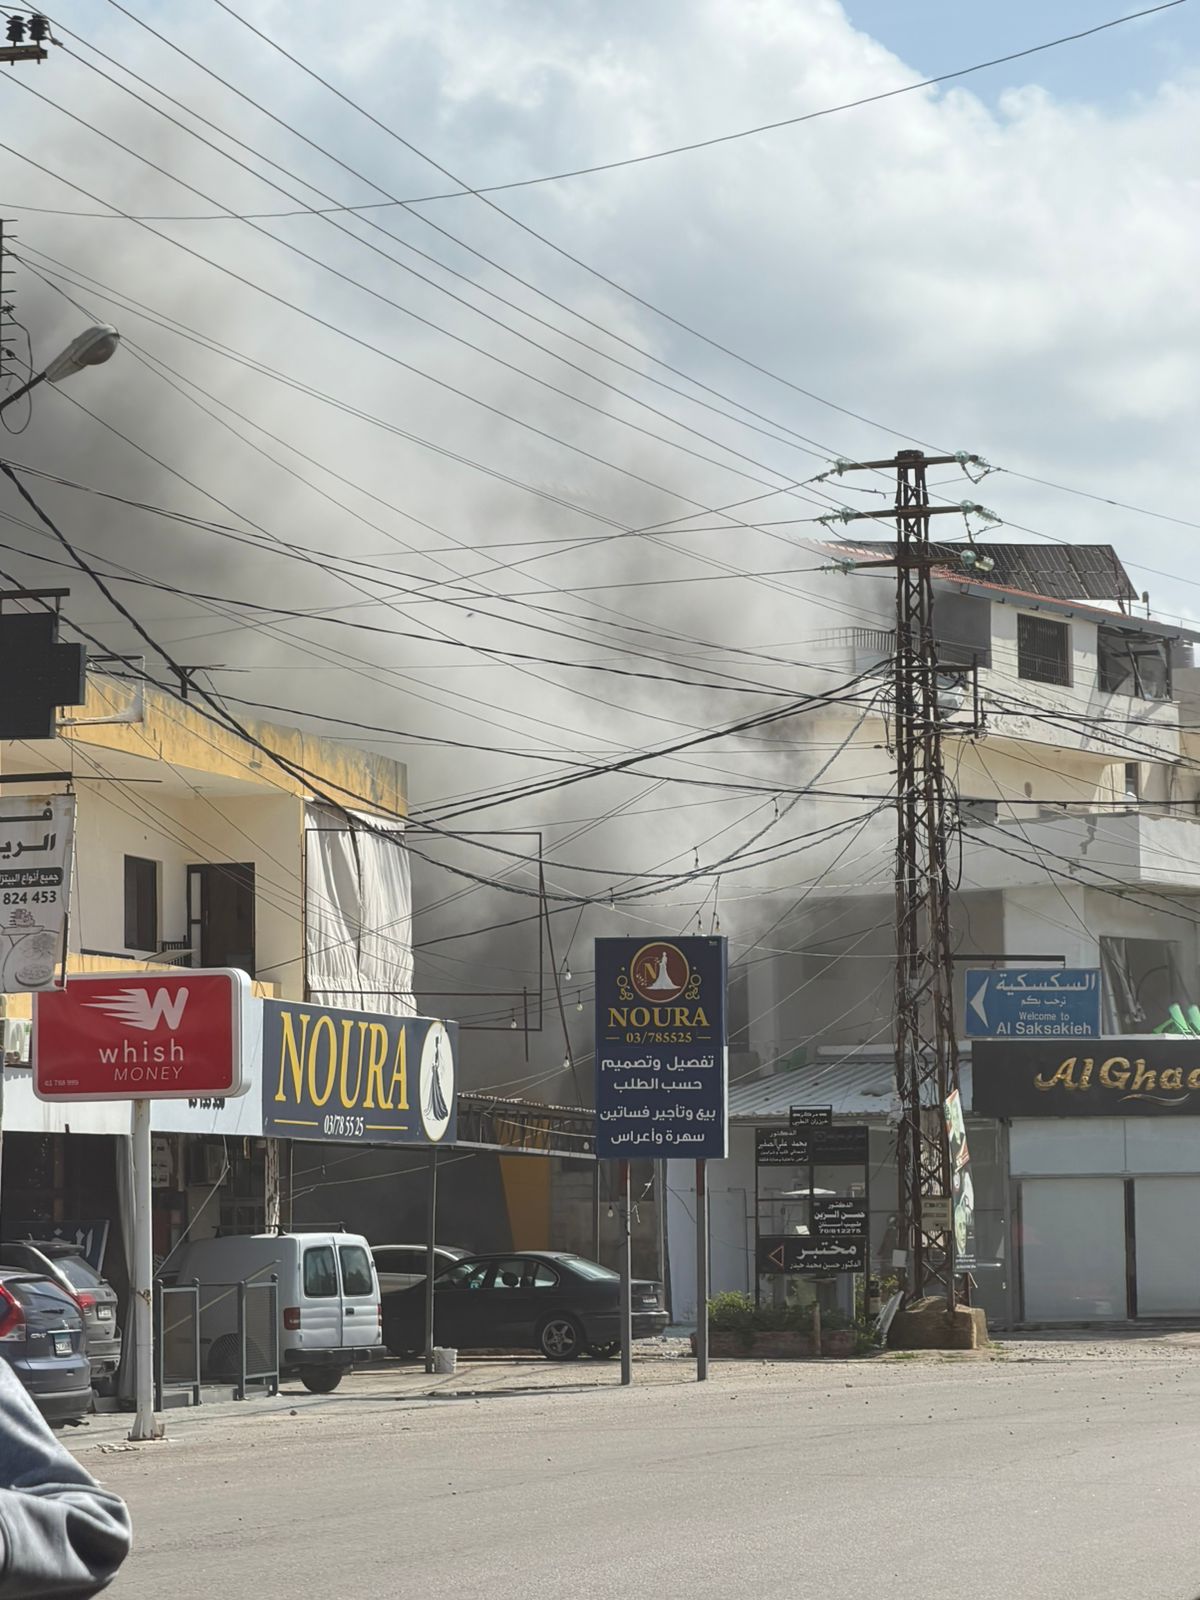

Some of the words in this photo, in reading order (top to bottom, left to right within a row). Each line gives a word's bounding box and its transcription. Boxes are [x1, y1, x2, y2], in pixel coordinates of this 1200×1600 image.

[21, 870, 39, 885] أنواع
[40, 873, 59, 884] جميع
[3, 892, 28, 905] 824
[32, 891, 57, 903] 453
[996, 972, 1096, 995] السكسكية
[1021, 995, 1041, 1007] بكم
[608, 1007, 710, 1027] NOURA
[1019, 1011, 1056, 1021] Welcome
[1061, 1012, 1070, 1021] to
[996, 1022, 1011, 1034] Al
[1015, 1021, 1092, 1035] Saksakieh
[626, 1031, 692, 1044] 03/785525
[98, 1039, 184, 1064] whish
[274, 1011, 409, 1110] NOURA
[601, 1056, 661, 1072] وتصميم
[666, 1055, 714, 1072] تفصيل
[114, 1066, 184, 1081] MONEY
[613, 1078, 659, 1093] الطلب
[661, 1080, 702, 1093] حسب
[600, 1104, 650, 1121] فساتين
[652, 1104, 694, 1122] وتأجير
[695, 1107, 716, 1121] بيع
[611, 1128, 662, 1144] وأعراس
[666, 1129, 705, 1143] سهرة
[796, 1240, 857, 1259] مختبر
[823, 1262, 840, 1271] حسين
[841, 1260, 862, 1269] الدكتور
